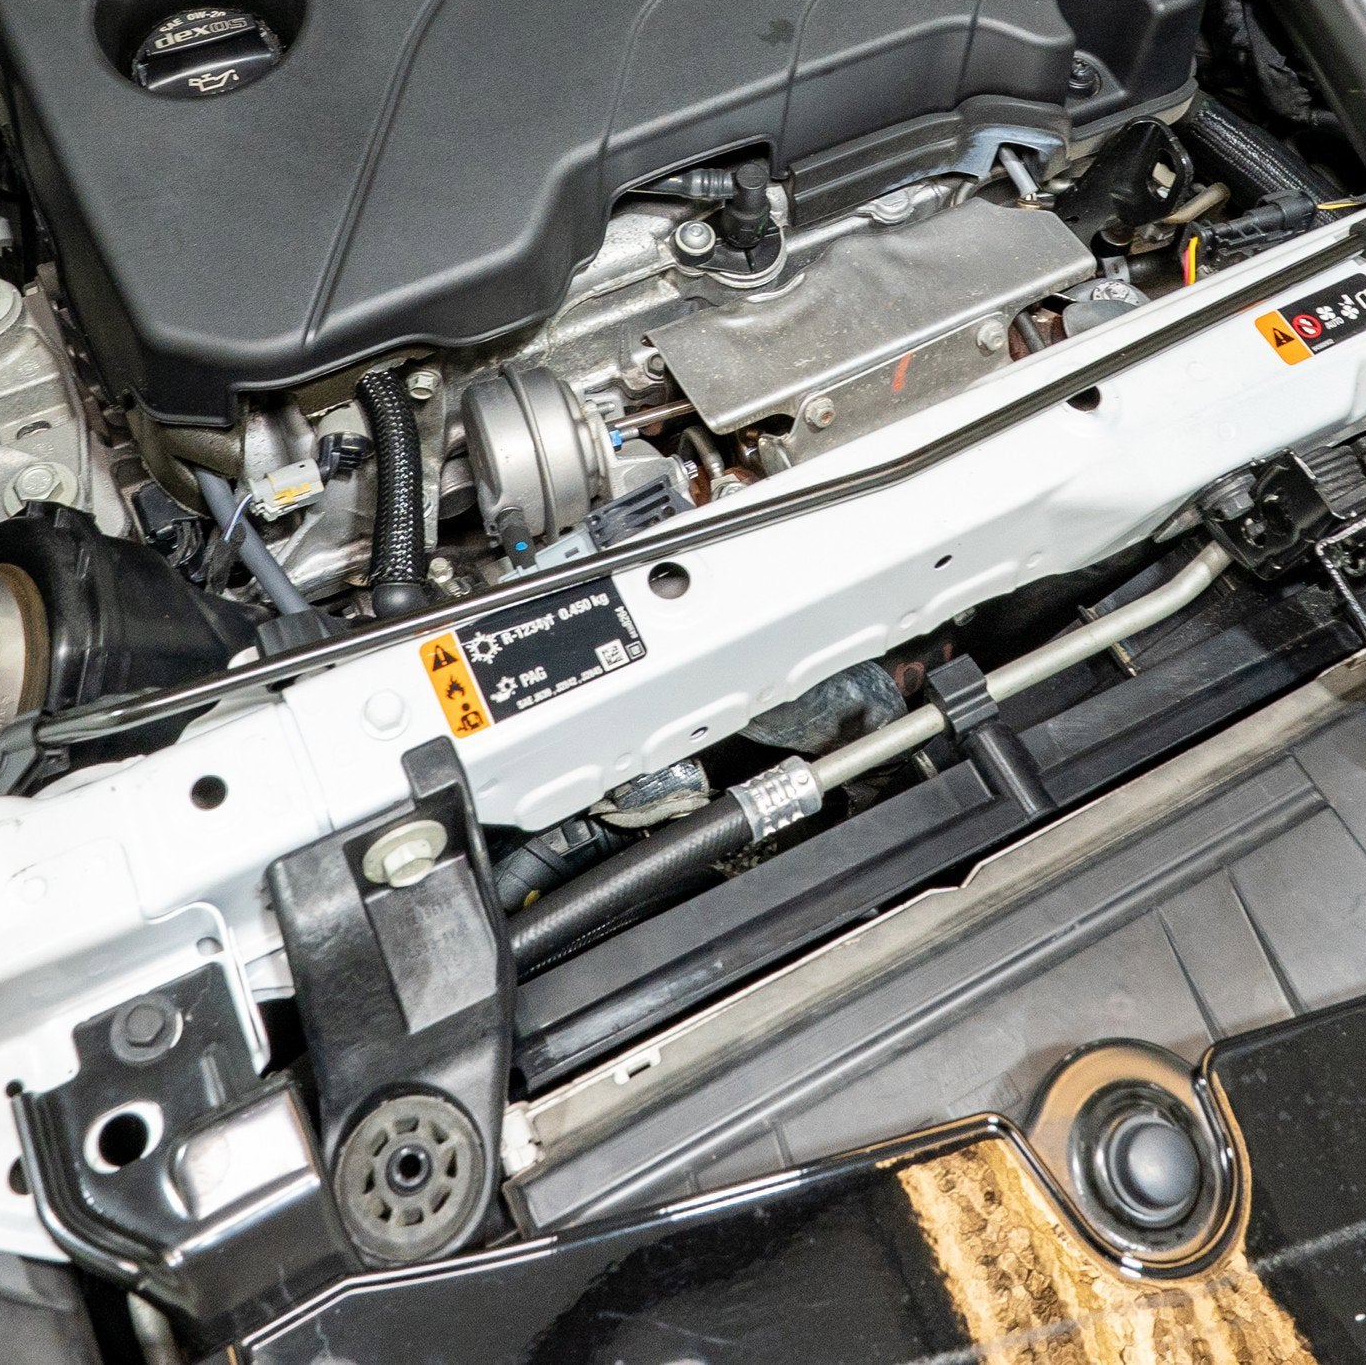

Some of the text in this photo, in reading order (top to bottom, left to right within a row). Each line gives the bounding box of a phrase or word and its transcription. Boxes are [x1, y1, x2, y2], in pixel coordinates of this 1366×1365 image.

[154, 17, 248, 49] dexos
[159, 17, 184, 33] SAE
[558, 598, 592, 621] 0.450
[592, 592, 610, 609] kg
[519, 666, 548, 688] PAG
